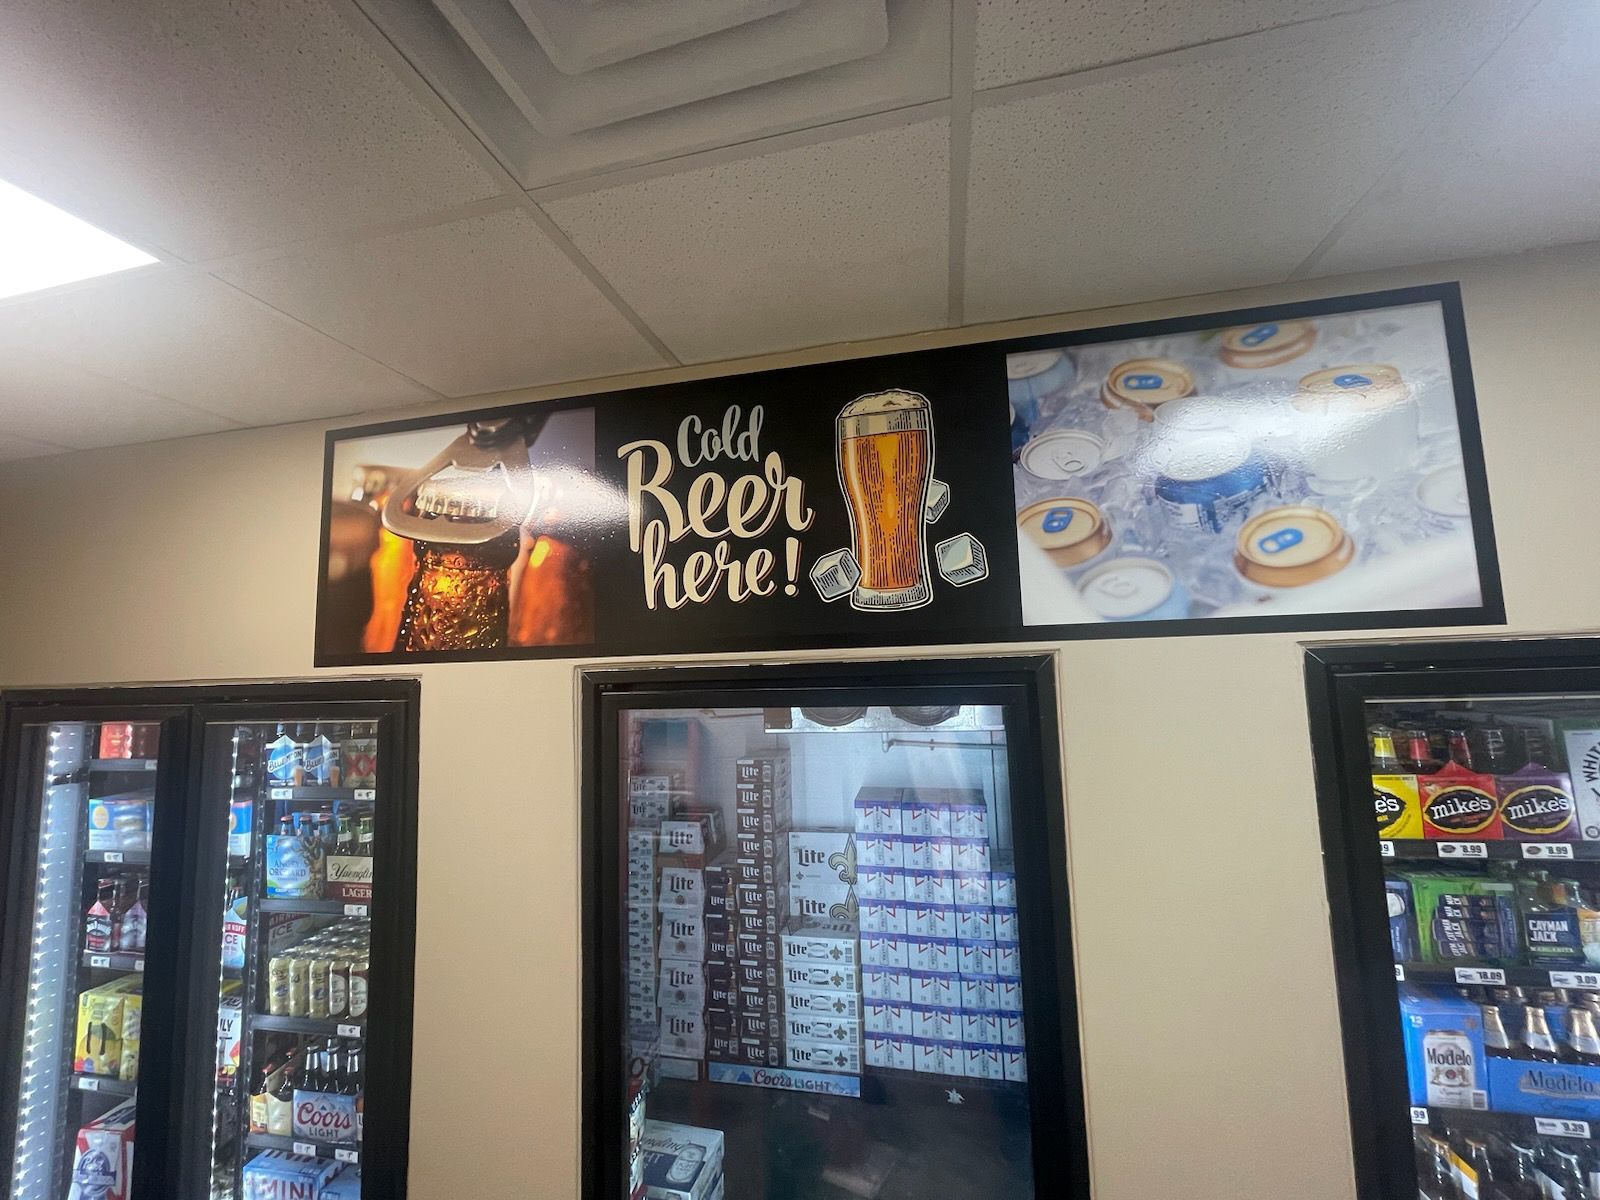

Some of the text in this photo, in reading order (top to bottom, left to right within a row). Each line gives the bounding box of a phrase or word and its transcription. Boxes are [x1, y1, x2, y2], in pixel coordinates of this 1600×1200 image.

[677, 404, 764, 468] Cold
[617, 439, 816, 553] Beer
[643, 519, 801, 611] here!
[742, 766, 759, 778] Lite
[742, 790, 759, 803] Lite
[1432, 797, 1492, 820] mike's
[1508, 797, 1569, 820] mike's
[742, 816, 759, 828] Lite
[669, 831, 693, 847] Lite
[743, 841, 760, 853] Lite
[798, 848, 825, 867] Lite
[743, 866, 759, 878] Lite
[670, 876, 694, 893] Lite
[342, 888, 372, 898] LAGER
[745, 890, 762, 903] Lite
[710, 896, 724, 906] Lite
[799, 899, 826, 917] Lite
[745, 916, 762, 929] Lite
[1529, 919, 1569, 931] CAYMAN
[272, 922, 294, 939] ICE
[670, 921, 694, 939] Lite
[1530, 931, 1558, 942] JACK
[225, 934, 238, 944] CE
[711, 943, 725, 952] Lite
[744, 942, 762, 954] Lite
[788, 943, 807, 956] Lite
[669, 969, 694, 987] Lite
[745, 968, 763, 980] Lite
[788, 969, 808, 983] Lite
[712, 990, 727, 1000] Lite
[746, 995, 764, 1007] Lite
[790, 996, 810, 1009] Lite
[748, 1019, 766, 1031] Lite
[1409, 1015, 1423, 1024] 12
[669, 1018, 694, 1035] Lite
[792, 1022, 811, 1035] Lite
[747, 1047, 765, 1059] Lite
[792, 1049, 812, 1062] Lite
[1426, 1047, 1472, 1066] Modelo
[753, 1069, 832, 1091] Coors LIGHT
[1528, 1070, 1594, 1093] Modelo
[297, 1102, 351, 1129] Coors
[309, 1127, 339, 1137] LIGHT
